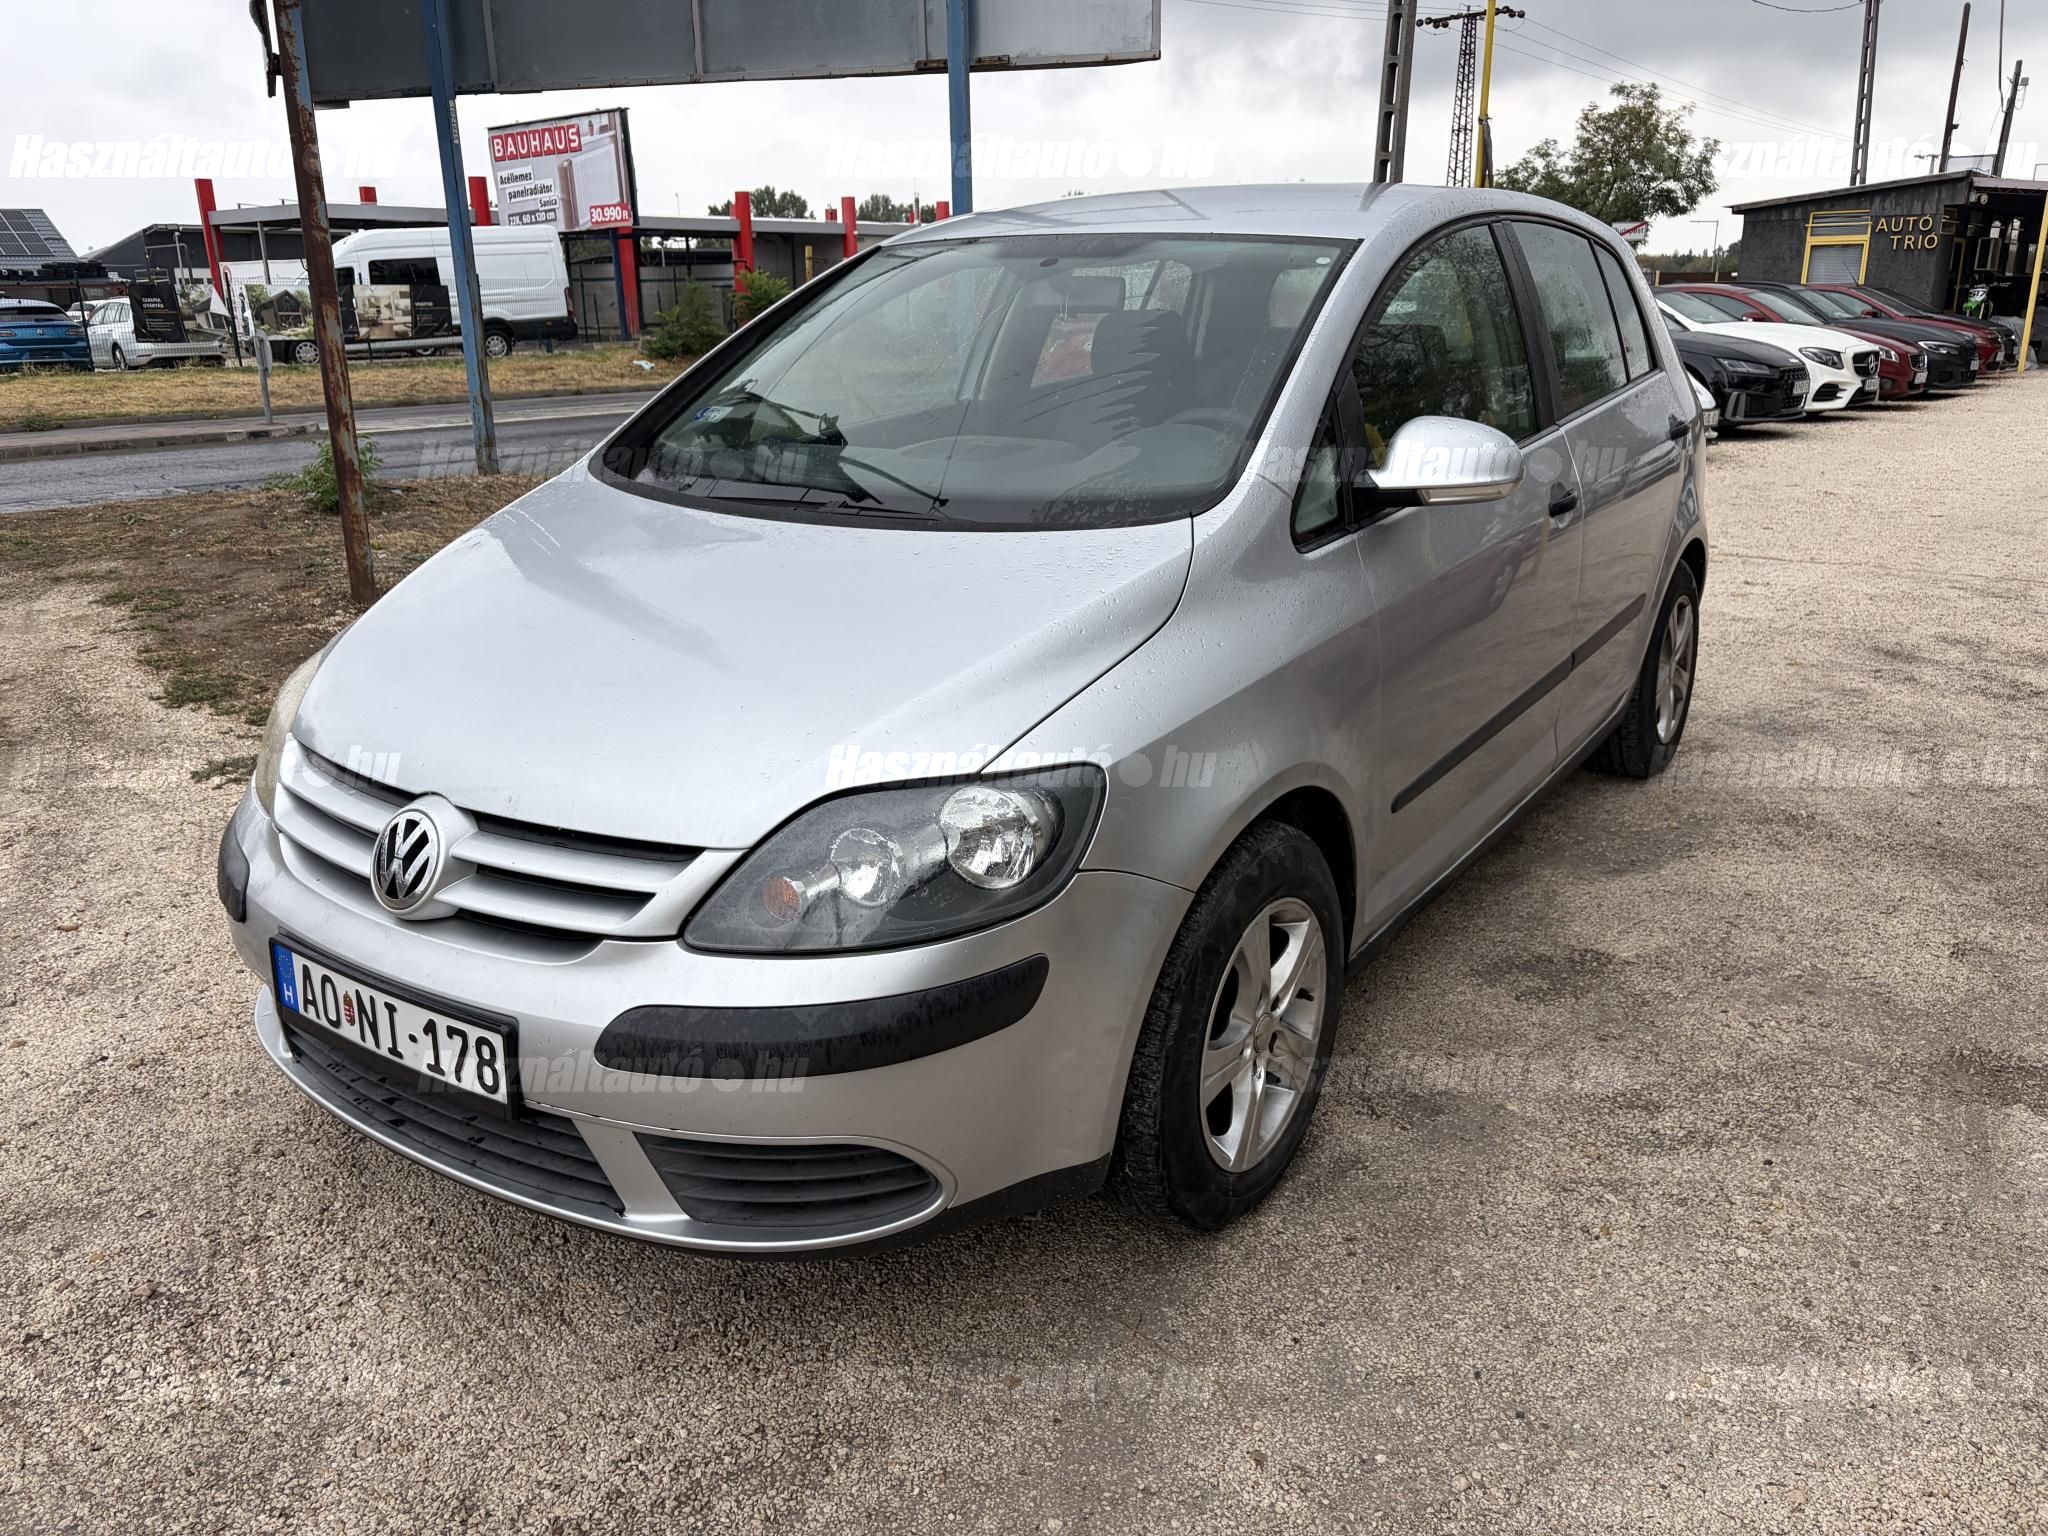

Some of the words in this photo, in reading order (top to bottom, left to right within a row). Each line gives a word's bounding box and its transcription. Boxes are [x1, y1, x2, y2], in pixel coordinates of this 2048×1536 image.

[493, 127, 579, 157] BAUHAUS
[500, 172, 532, 185] Acéllemez
[522, 213, 531, 224] 60
[590, 206, 621, 222] 30.990
[1875, 213, 1933, 233] AUTÓ
[1890, 231, 1938, 250] TRIÓ
[284, 983, 294, 1004] H
